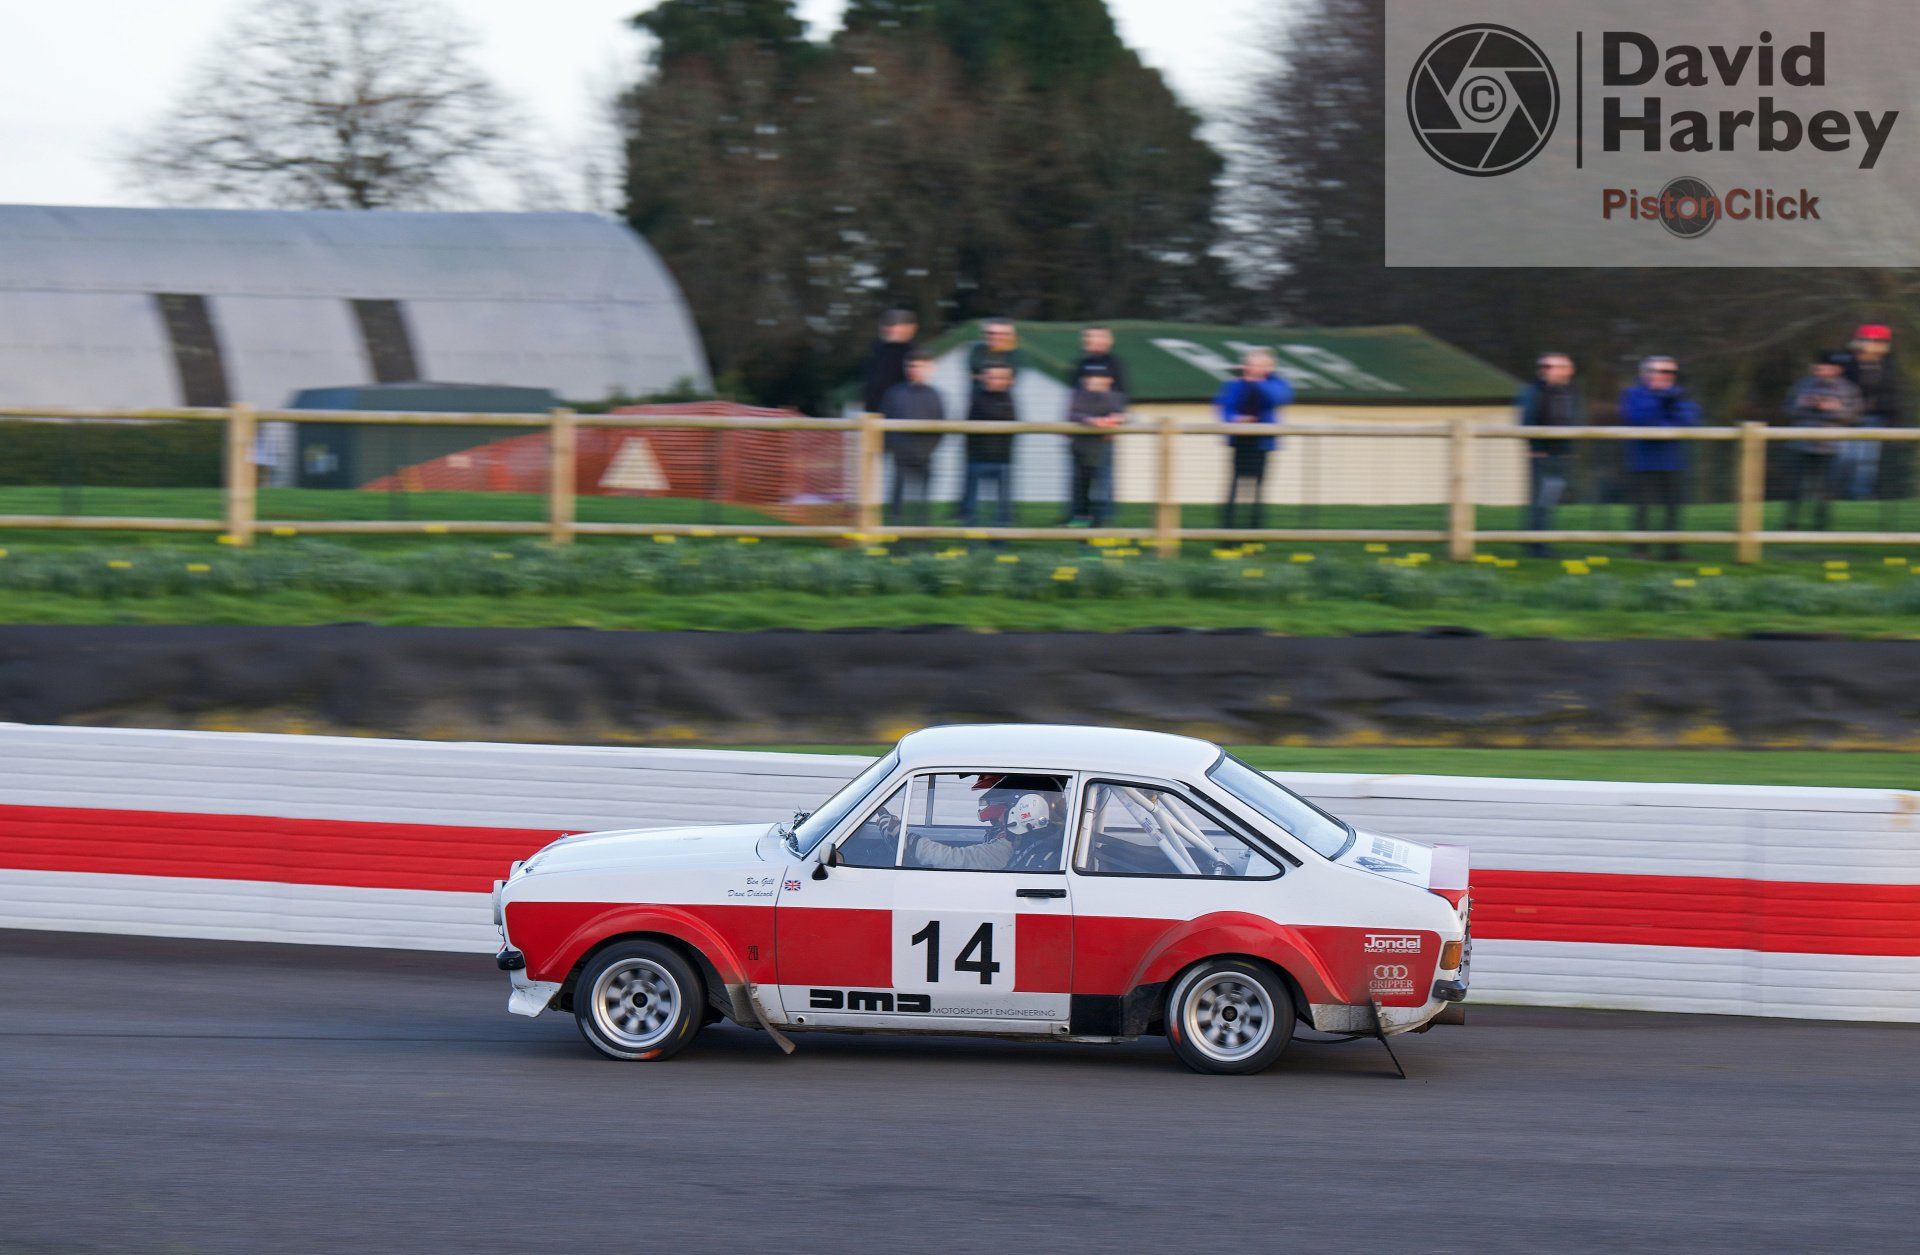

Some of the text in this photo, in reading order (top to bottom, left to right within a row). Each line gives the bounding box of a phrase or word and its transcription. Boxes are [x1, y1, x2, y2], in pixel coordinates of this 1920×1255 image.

[1364, 934, 1421, 948] Jondel
[911, 920, 1000, 985] 14
[1369, 980, 1414, 989] GRIPPER
[932, 1007, 1056, 1017] MOTORSPORT ENGINEERING
